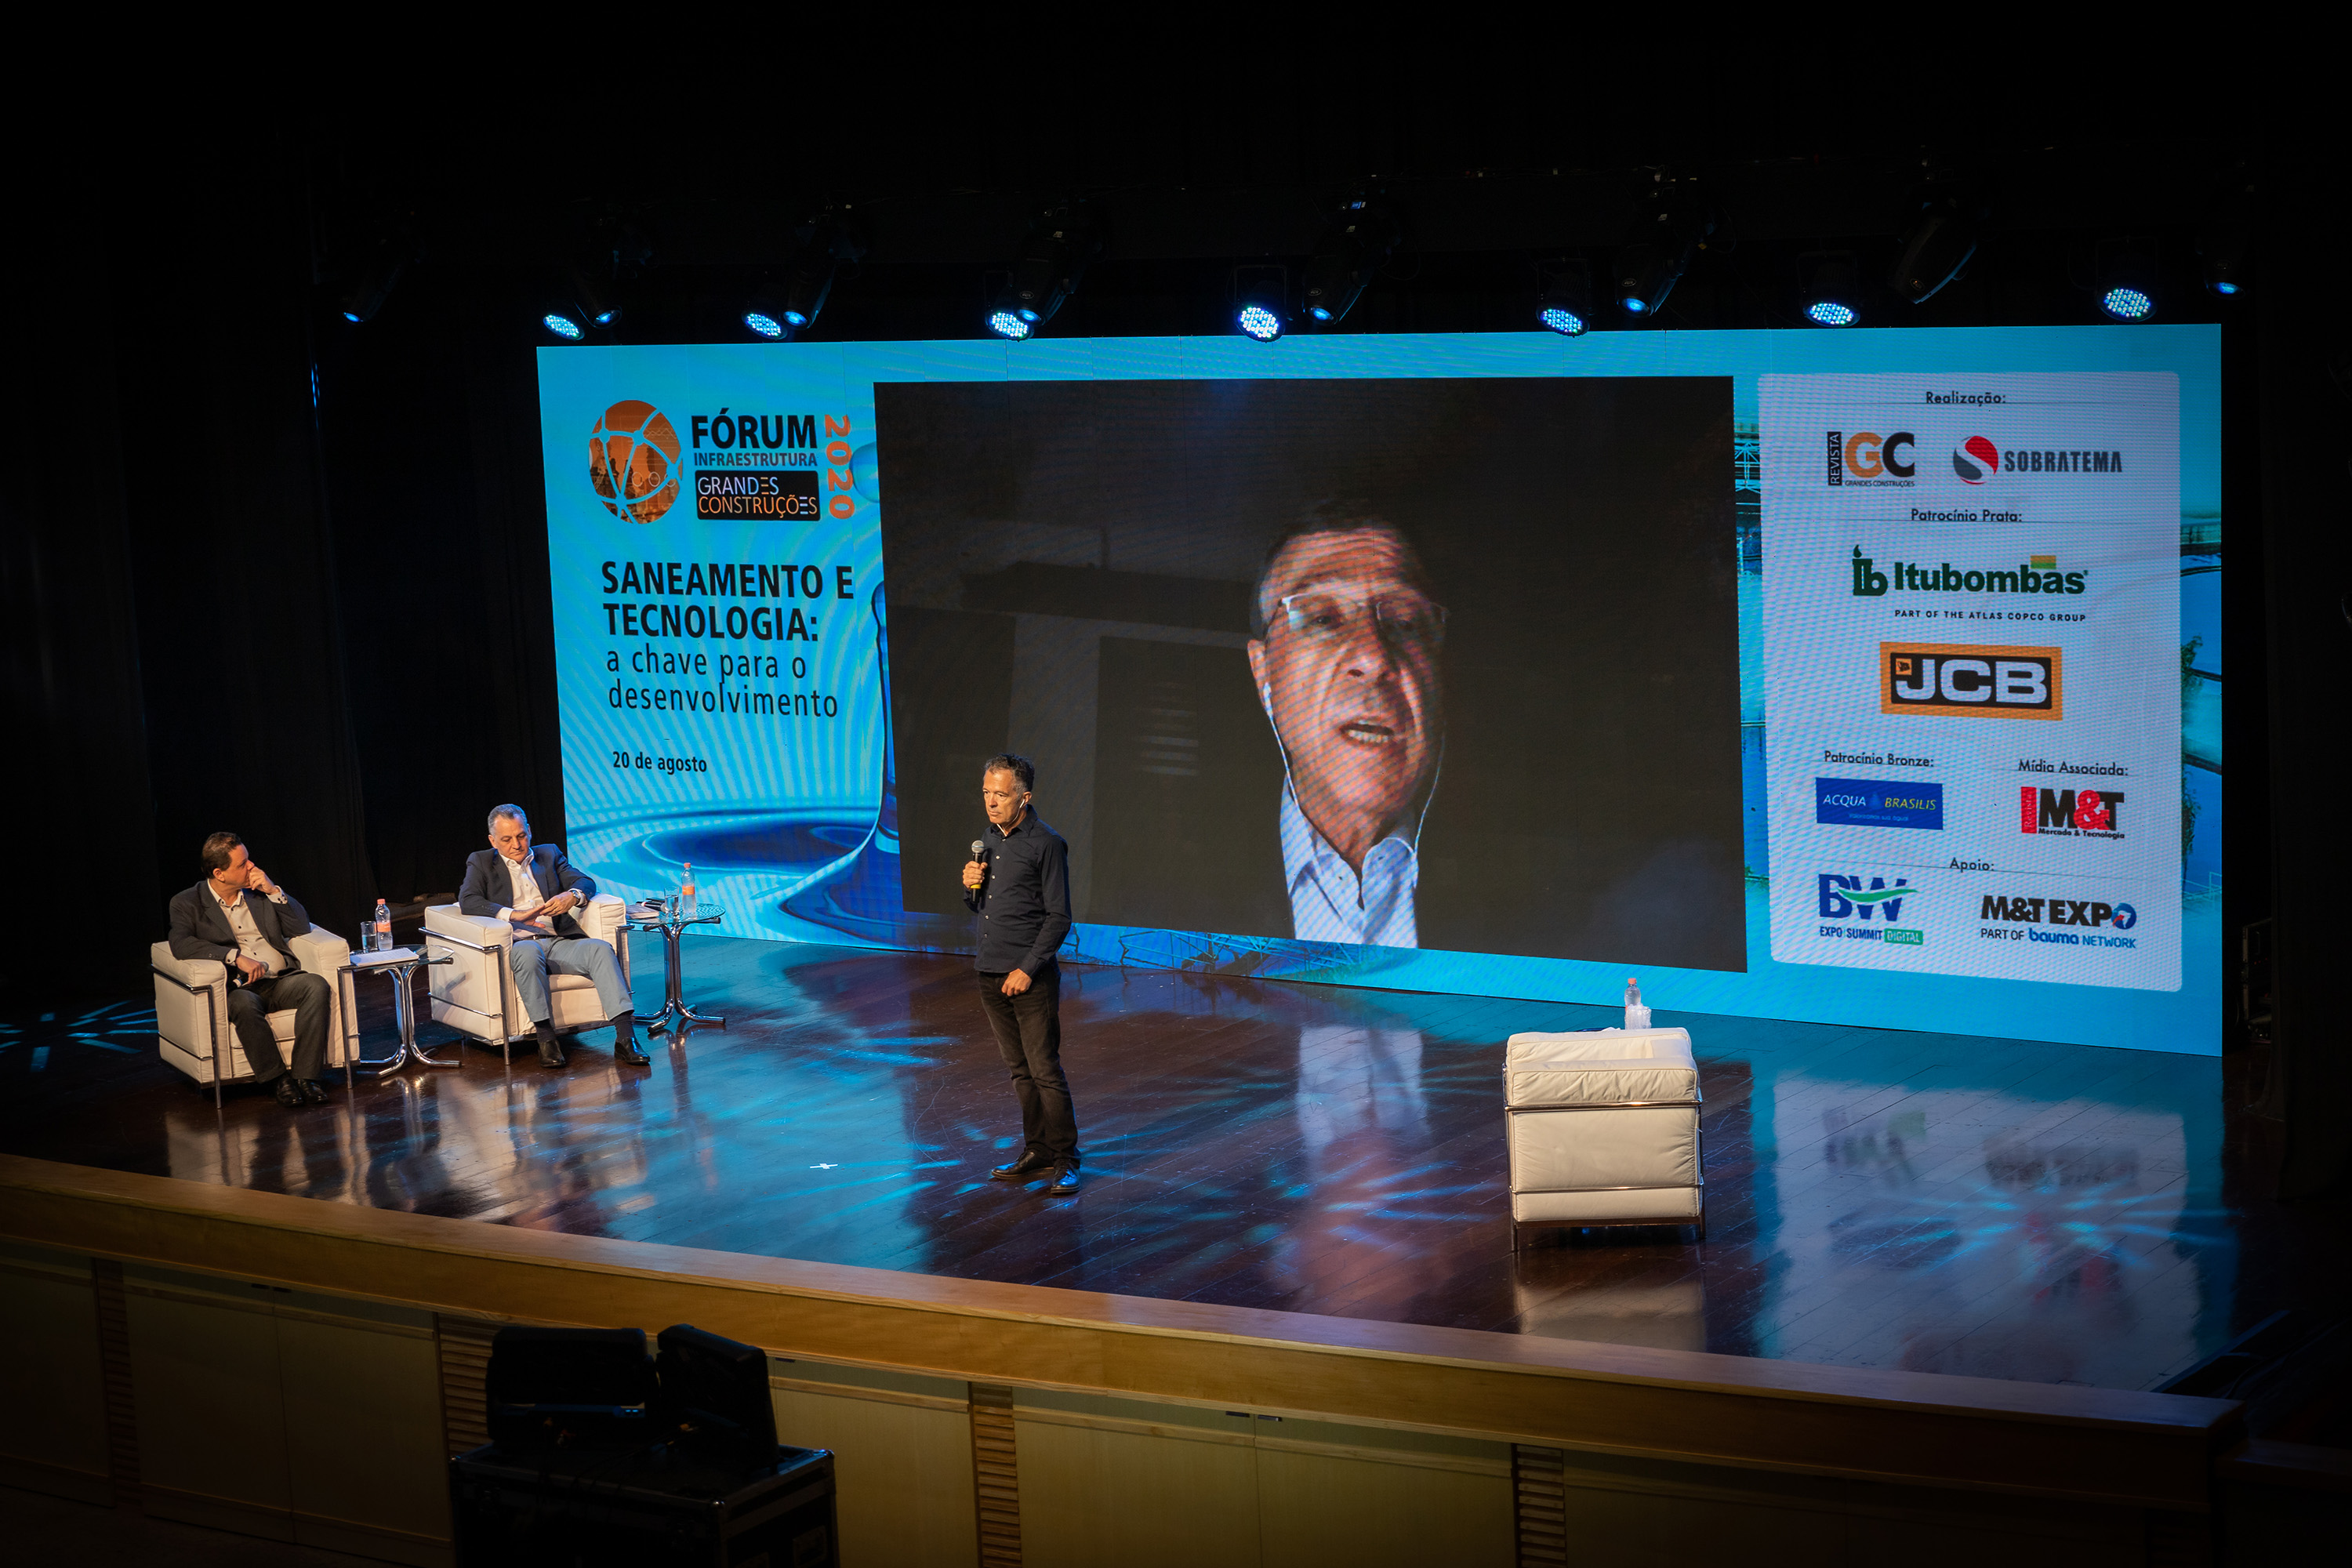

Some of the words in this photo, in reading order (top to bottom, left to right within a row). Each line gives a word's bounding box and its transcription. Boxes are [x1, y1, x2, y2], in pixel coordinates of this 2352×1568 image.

[1925, 390, 2006, 407] Realização:
[691, 408, 818, 449] FÓRUM
[693, 452, 818, 467] INFRAESTRUTURA
[1829, 434, 1840, 485] REVISTA
[1844, 431, 1916, 478] GC
[2004, 450, 2123, 473] SOBRATEMA
[825, 414, 856, 520] 2020
[697, 476, 779, 496] GRANDES
[1872, 480, 1915, 488] CONSTRUÇÕES
[698, 495, 818, 518] CONSTRUÇÕES
[1911, 509, 1977, 523] Patrocínio
[1982, 510, 2023, 524] Prata:
[601, 561, 823, 599] SANEAMENTO
[836, 565, 855, 600] E
[603, 603, 818, 642] TECNOLOGIA:
[1894, 609, 1921, 618] PART
[1969, 612, 2003, 620] ATLAS
[2008, 612, 2045, 621] COPCO
[2049, 613, 2086, 622] GROUP
[606, 650, 619, 673] a
[632, 643, 707, 676] chave
[719, 654, 779, 684] para
[792, 657, 807, 679] o
[1895, 658, 2048, 704] JCB
[608, 678, 838, 718] desenvolvimento
[612, 750, 630, 769] 20
[635, 751, 652, 770] de
[657, 754, 707, 775] agosto
[1824, 750, 1882, 766] Patrocínio
[1887, 753, 1934, 768] Bronze:
[2018, 758, 2054, 774] Mídia
[2058, 760, 2129, 777] Associada:
[1823, 794, 1867, 808] ACQUA
[1884, 797, 1937, 811] BRASILIS
[2038, 788, 2125, 831] M&T
[2038, 828, 2072, 837] Mercado
[2082, 830, 2125, 840] Tecnologia
[1949, 857, 1994, 873] Apoio:
[1980, 895, 2045, 924] M&T
[1820, 926, 1842, 938] EXPO
[1846, 927, 1882, 941] SUMMIT
[1886, 930, 1920, 943] DIGITAL
[1980, 927, 2009, 940] PART
[2010, 930, 2025, 941] OF
[2028, 927, 2079, 945] bauma
[2082, 935, 2136, 949] NETWORK
